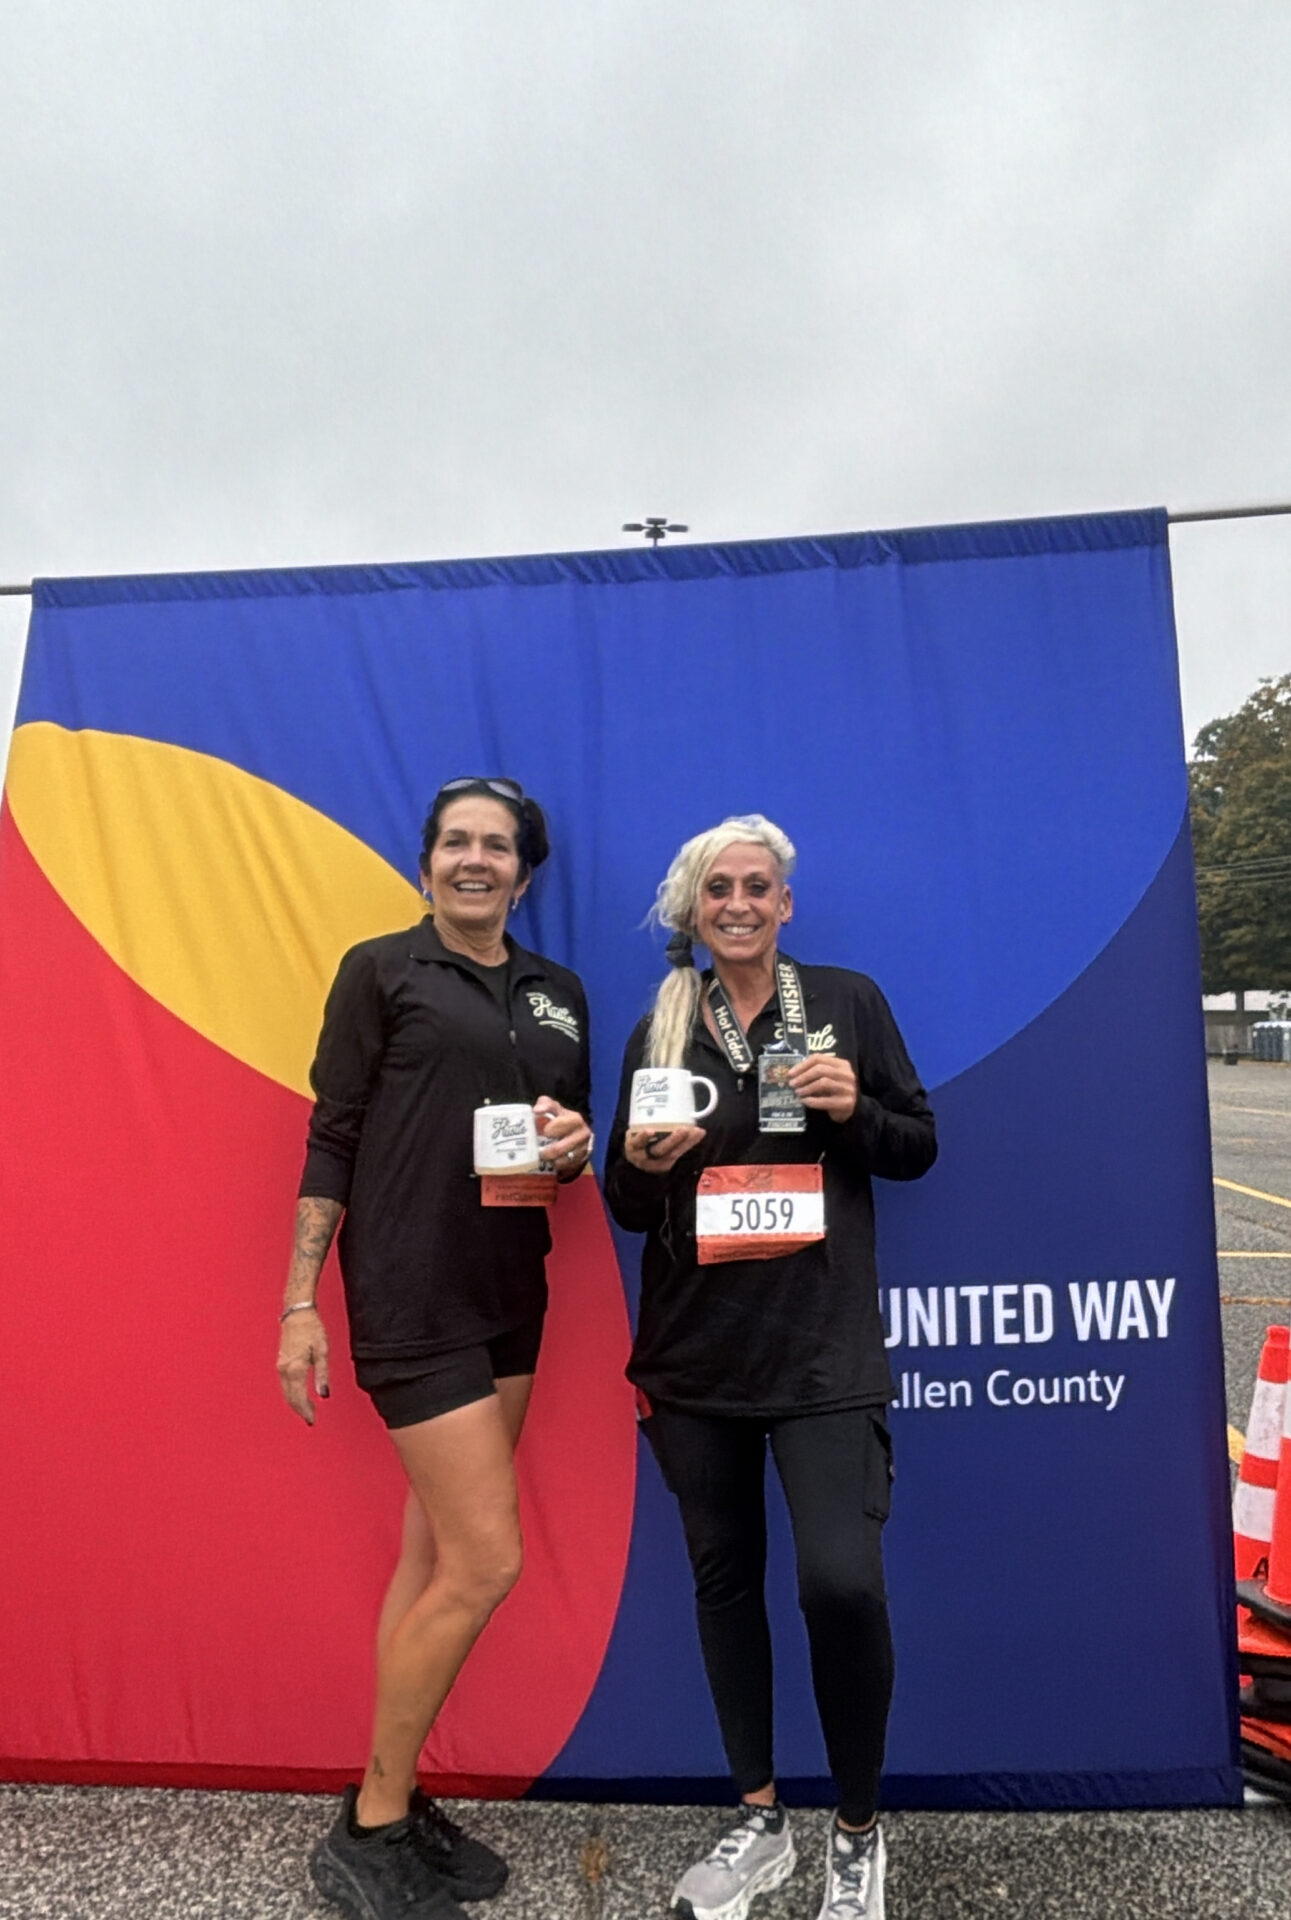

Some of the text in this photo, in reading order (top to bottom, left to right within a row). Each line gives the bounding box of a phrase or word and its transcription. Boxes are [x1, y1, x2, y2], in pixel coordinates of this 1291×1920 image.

[777, 963, 804, 1034] FINISHER
[715, 1005, 733, 1030] Hot
[724, 1029, 745, 1061] Cider
[730, 1198, 794, 1231] 5059
[878, 1278, 1176, 1348] UNITED WAY
[891, 1369, 1126, 1411] llen County
